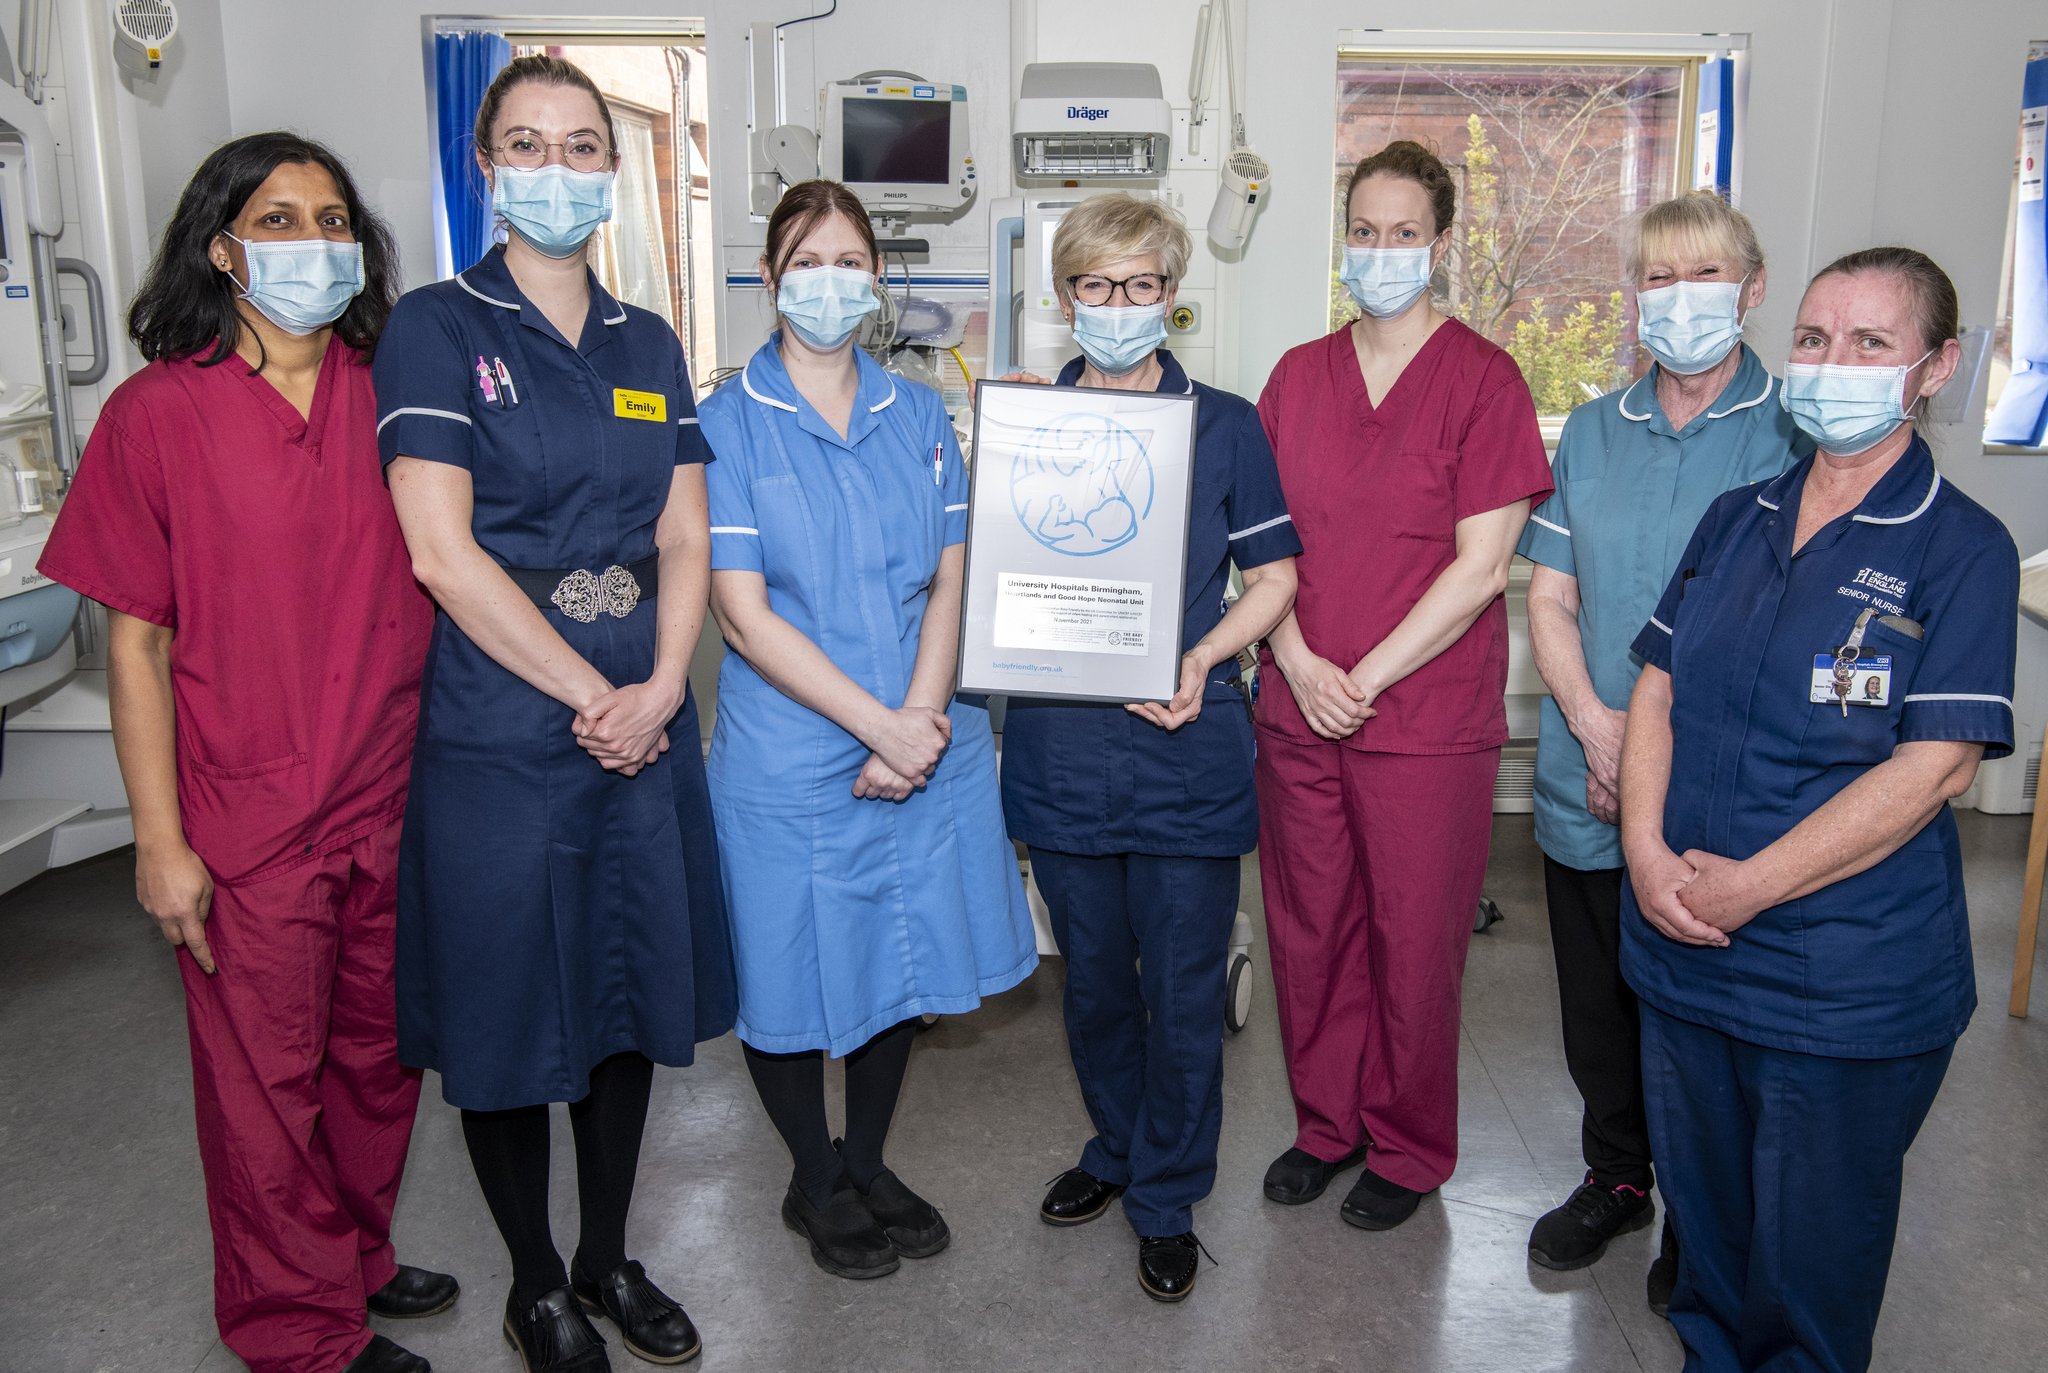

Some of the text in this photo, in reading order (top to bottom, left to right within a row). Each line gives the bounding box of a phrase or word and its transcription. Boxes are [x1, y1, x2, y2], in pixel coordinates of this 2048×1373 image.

[1067, 106, 1109, 121] Dräger
[626, 400, 656, 415] Emily
[1872, 571, 1898, 584] HEART
[1007, 580, 1143, 596] University Hospitals Birmingham,
[1868, 576, 1906, 595] ENGLAND
[1078, 595, 1096, 603] Hope
[1097, 596, 1129, 605] Neonatal
[1129, 598, 1144, 606] Unit
[1837, 586, 1905, 617] SENIOR NURSE
